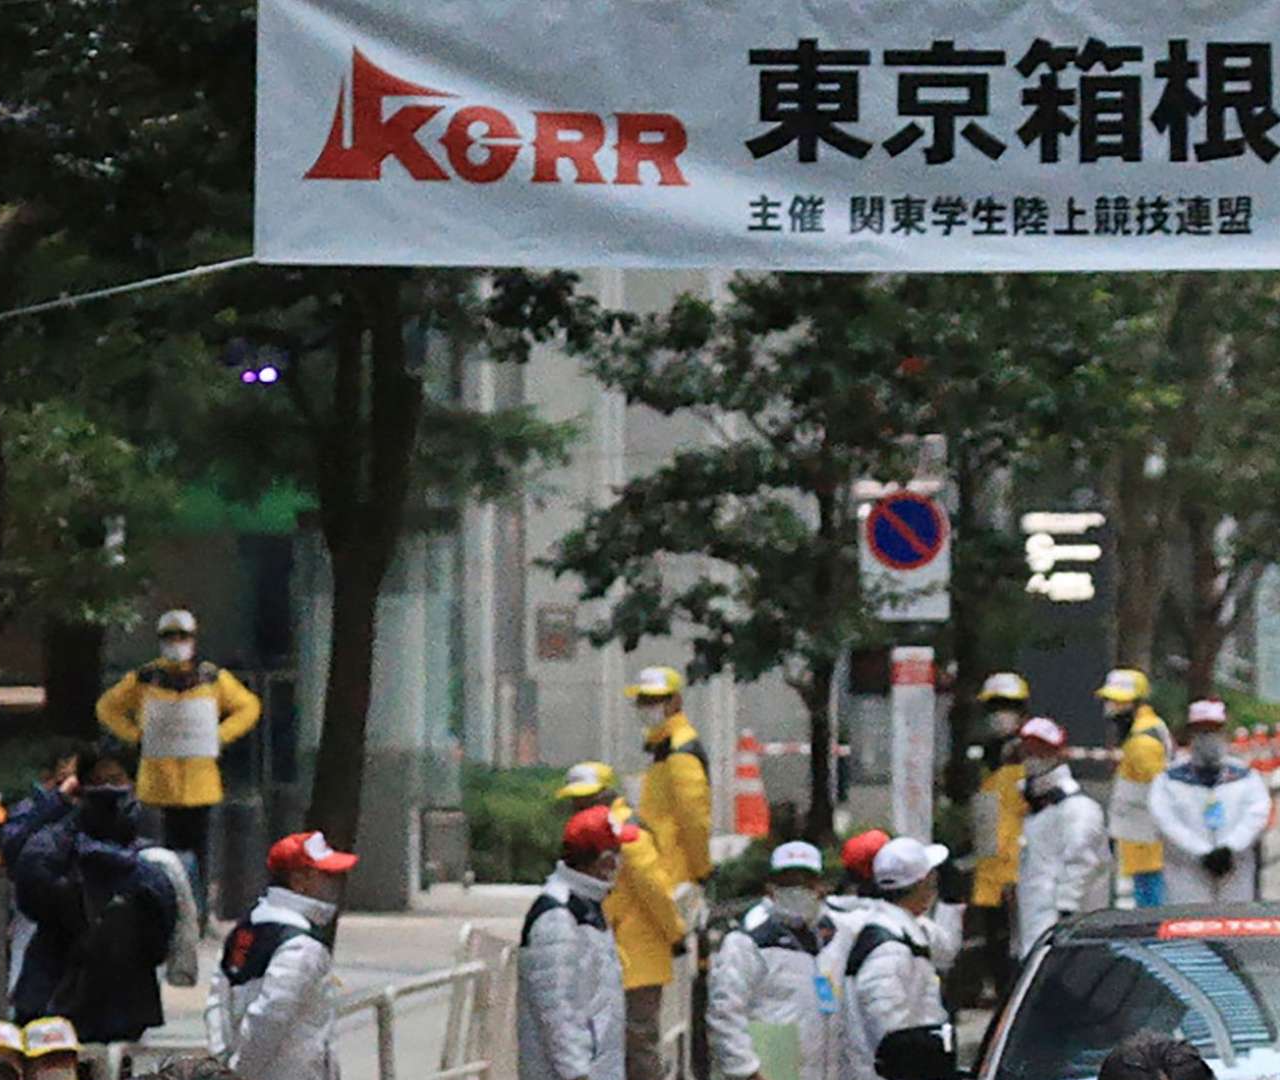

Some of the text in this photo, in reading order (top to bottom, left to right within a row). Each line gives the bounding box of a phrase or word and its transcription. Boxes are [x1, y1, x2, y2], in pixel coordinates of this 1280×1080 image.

[308, 46, 687, 187] KGRR
[747, 194, 825, 234] 主催
[850, 193, 1253, 237] 関東学生陸上競技連盟
